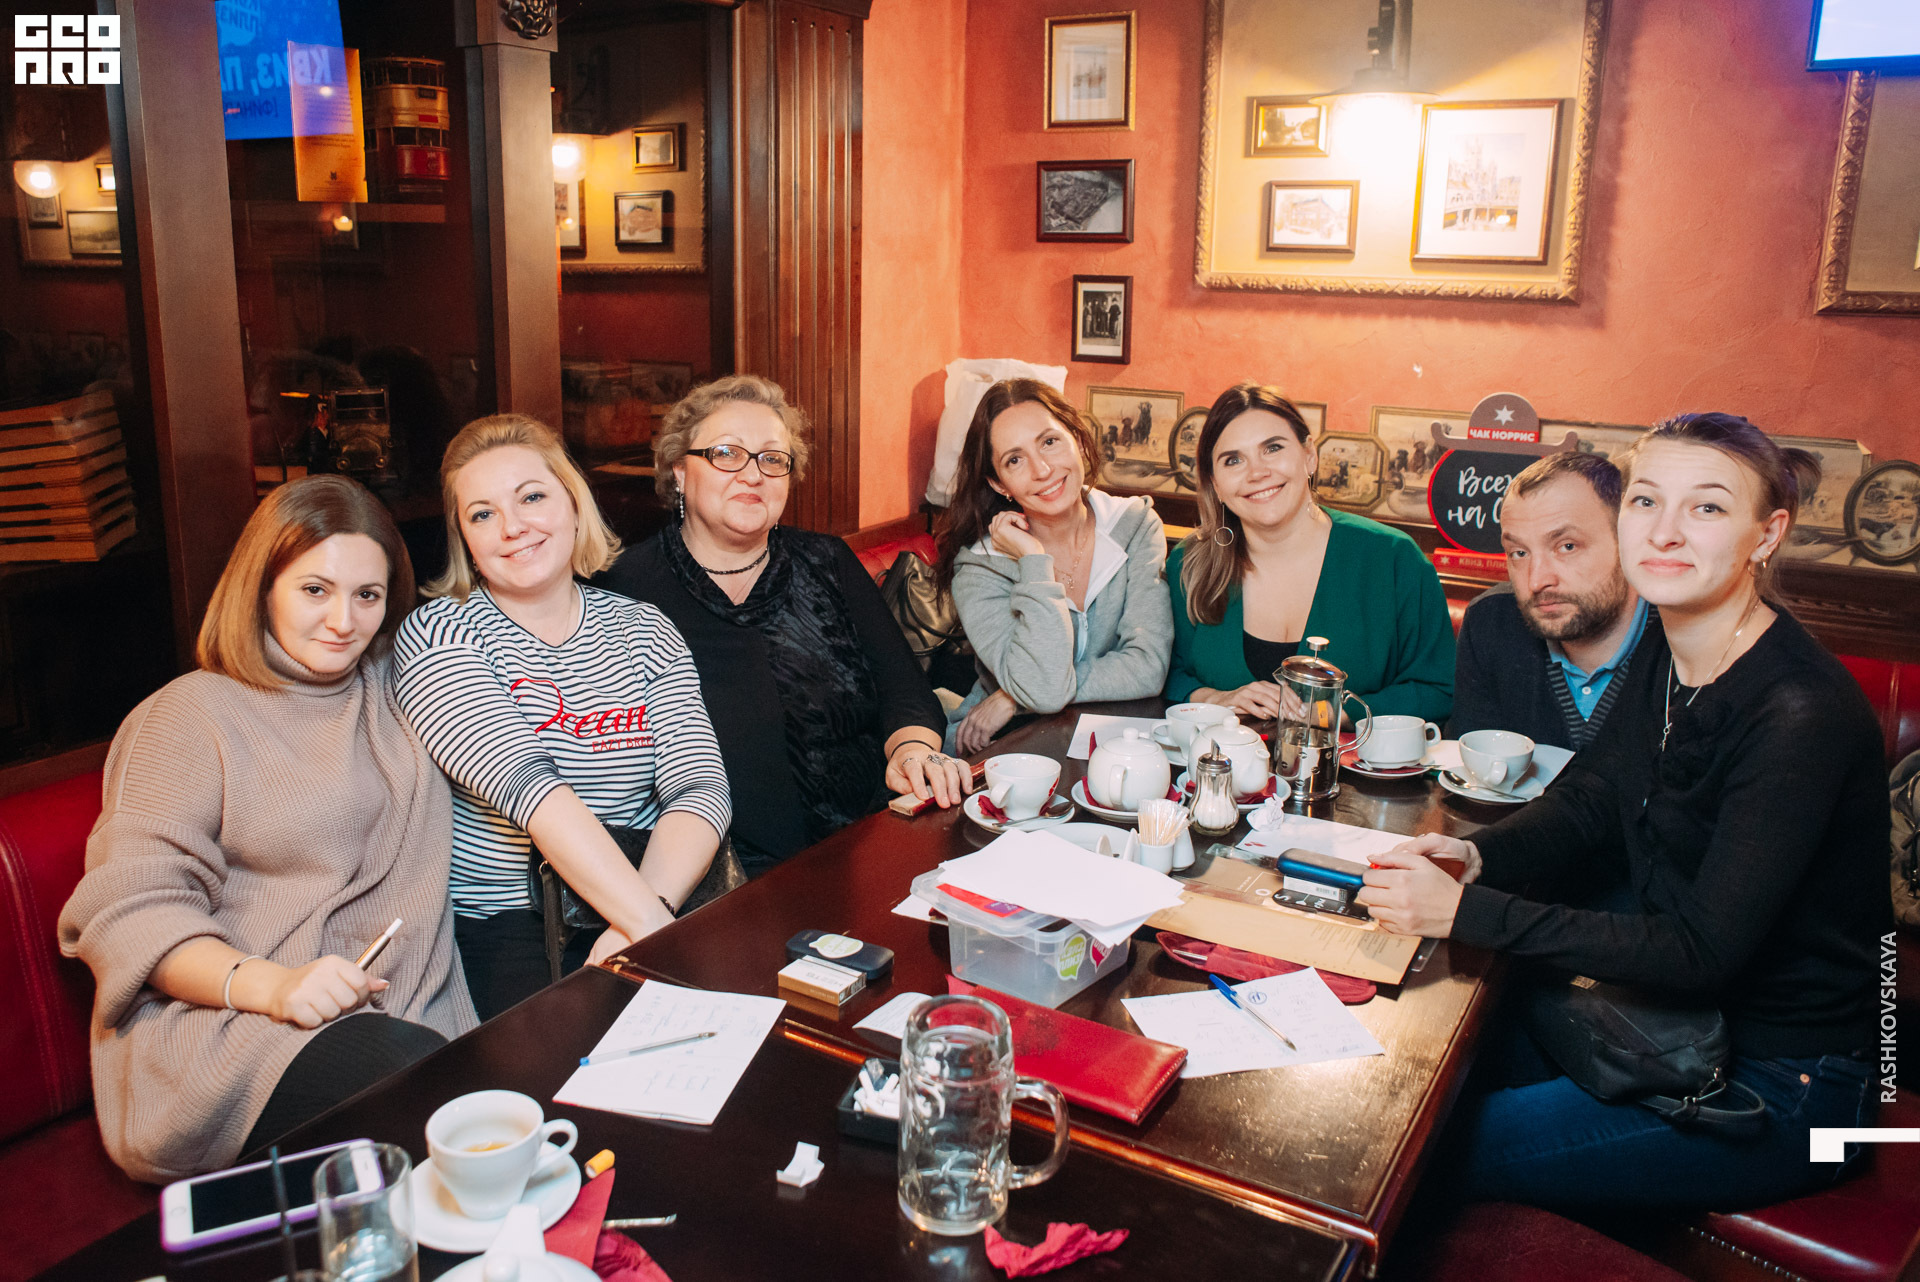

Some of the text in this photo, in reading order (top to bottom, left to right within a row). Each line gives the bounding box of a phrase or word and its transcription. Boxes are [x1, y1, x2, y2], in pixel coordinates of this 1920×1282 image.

[1469, 428, 1536, 442] ЧАК НОРРИС
[1447, 505, 1487, 529] на
[1486, 559, 1508, 569] ПЛИ
[591, 737, 622, 753] EAZY
